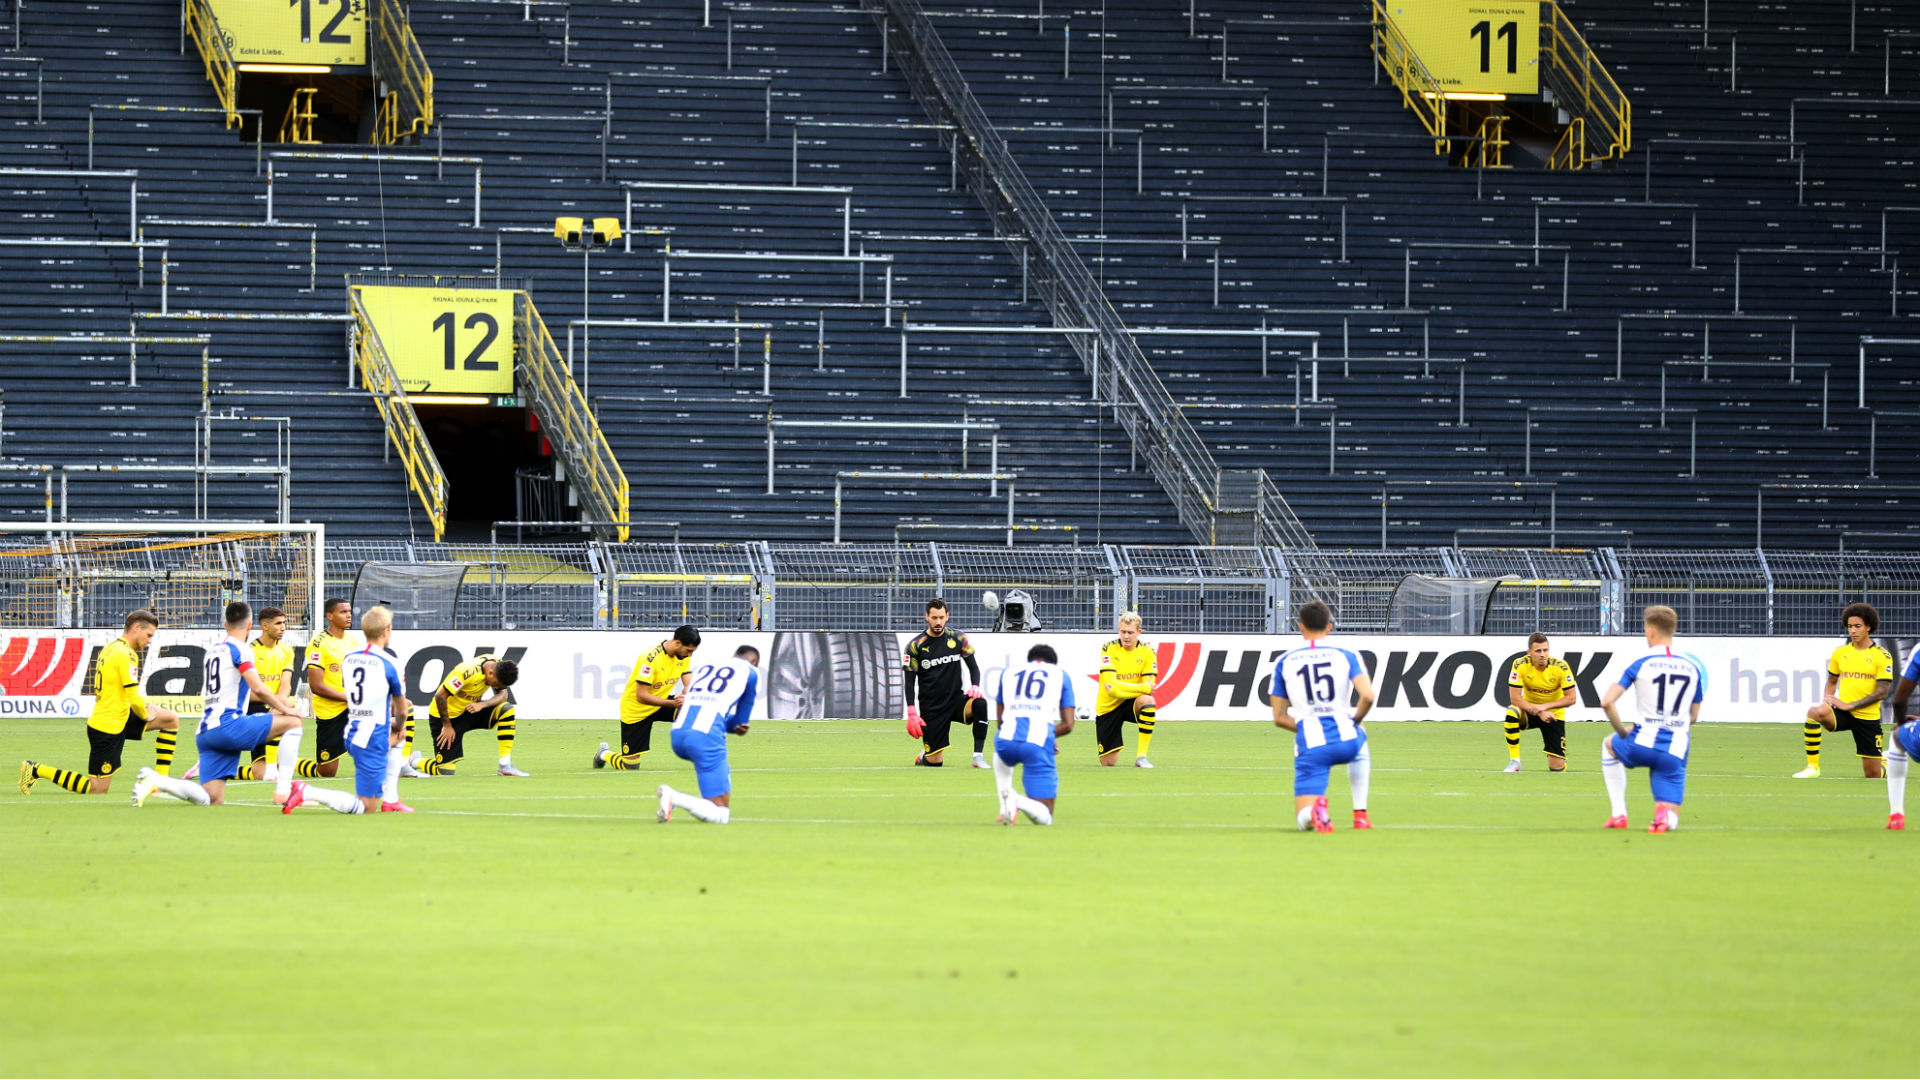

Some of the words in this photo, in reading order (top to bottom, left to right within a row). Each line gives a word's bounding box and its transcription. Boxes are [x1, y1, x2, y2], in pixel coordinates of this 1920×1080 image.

[290, 0, 351, 43] 12
[1470, 21, 1517, 73] 11
[433, 312, 499, 371] 12
[205, 656, 221, 695] 19
[350, 667, 365, 706] 3
[689, 664, 735, 693] 28
[1014, 669, 1048, 700] 16
[1195, 650, 1613, 708] HKOOK
[1296, 662, 1336, 706] 15
[1652, 672, 1691, 716] 17
[1842, 671, 1876, 680] EVONIK
